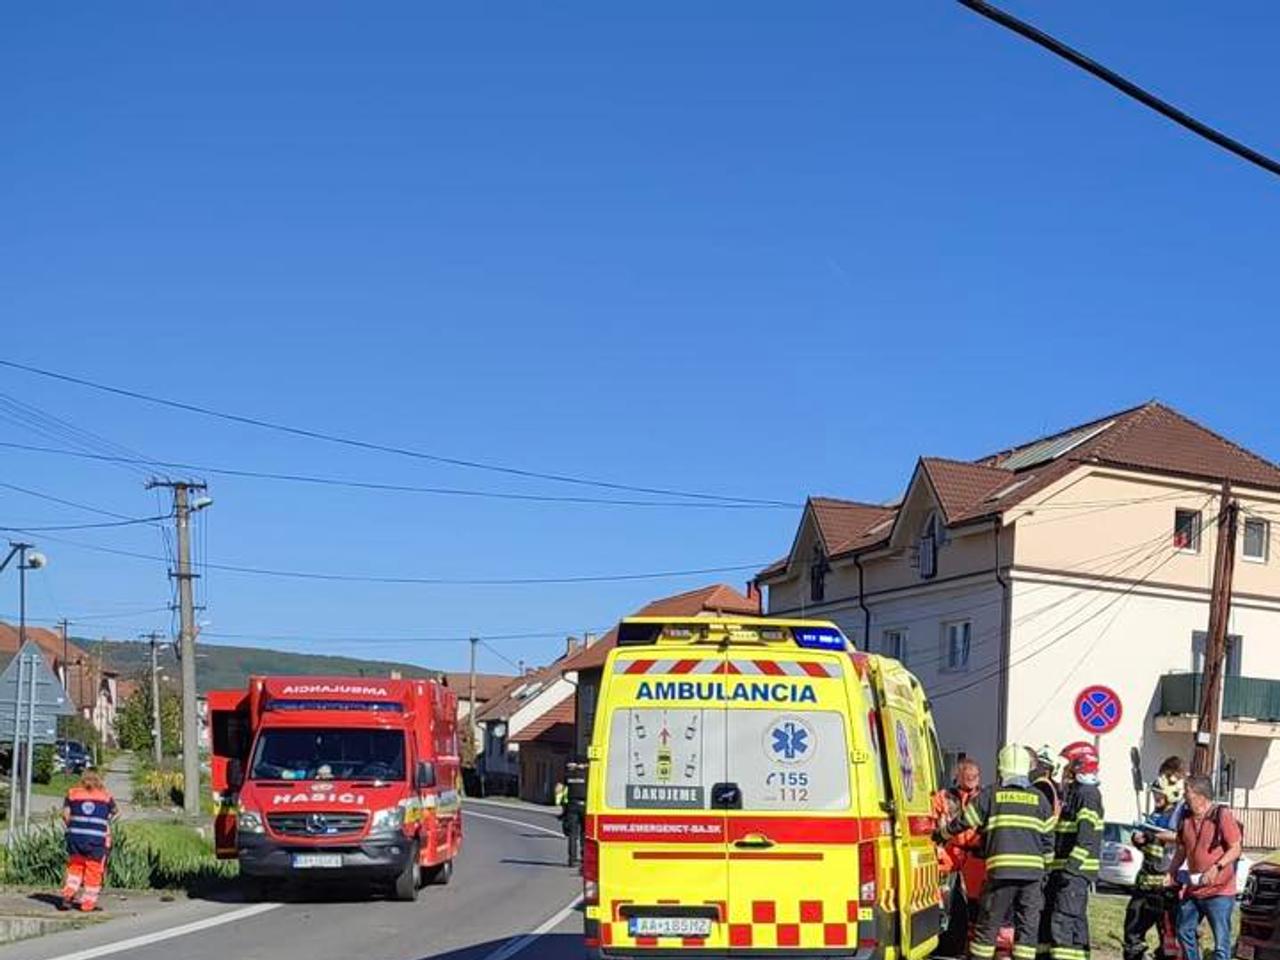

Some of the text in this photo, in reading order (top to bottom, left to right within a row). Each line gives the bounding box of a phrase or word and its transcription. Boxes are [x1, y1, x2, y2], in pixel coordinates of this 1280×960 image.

[635, 681, 818, 703] AMBULANCIA
[779, 772, 809, 787] 155
[780, 788, 809, 802] 112
